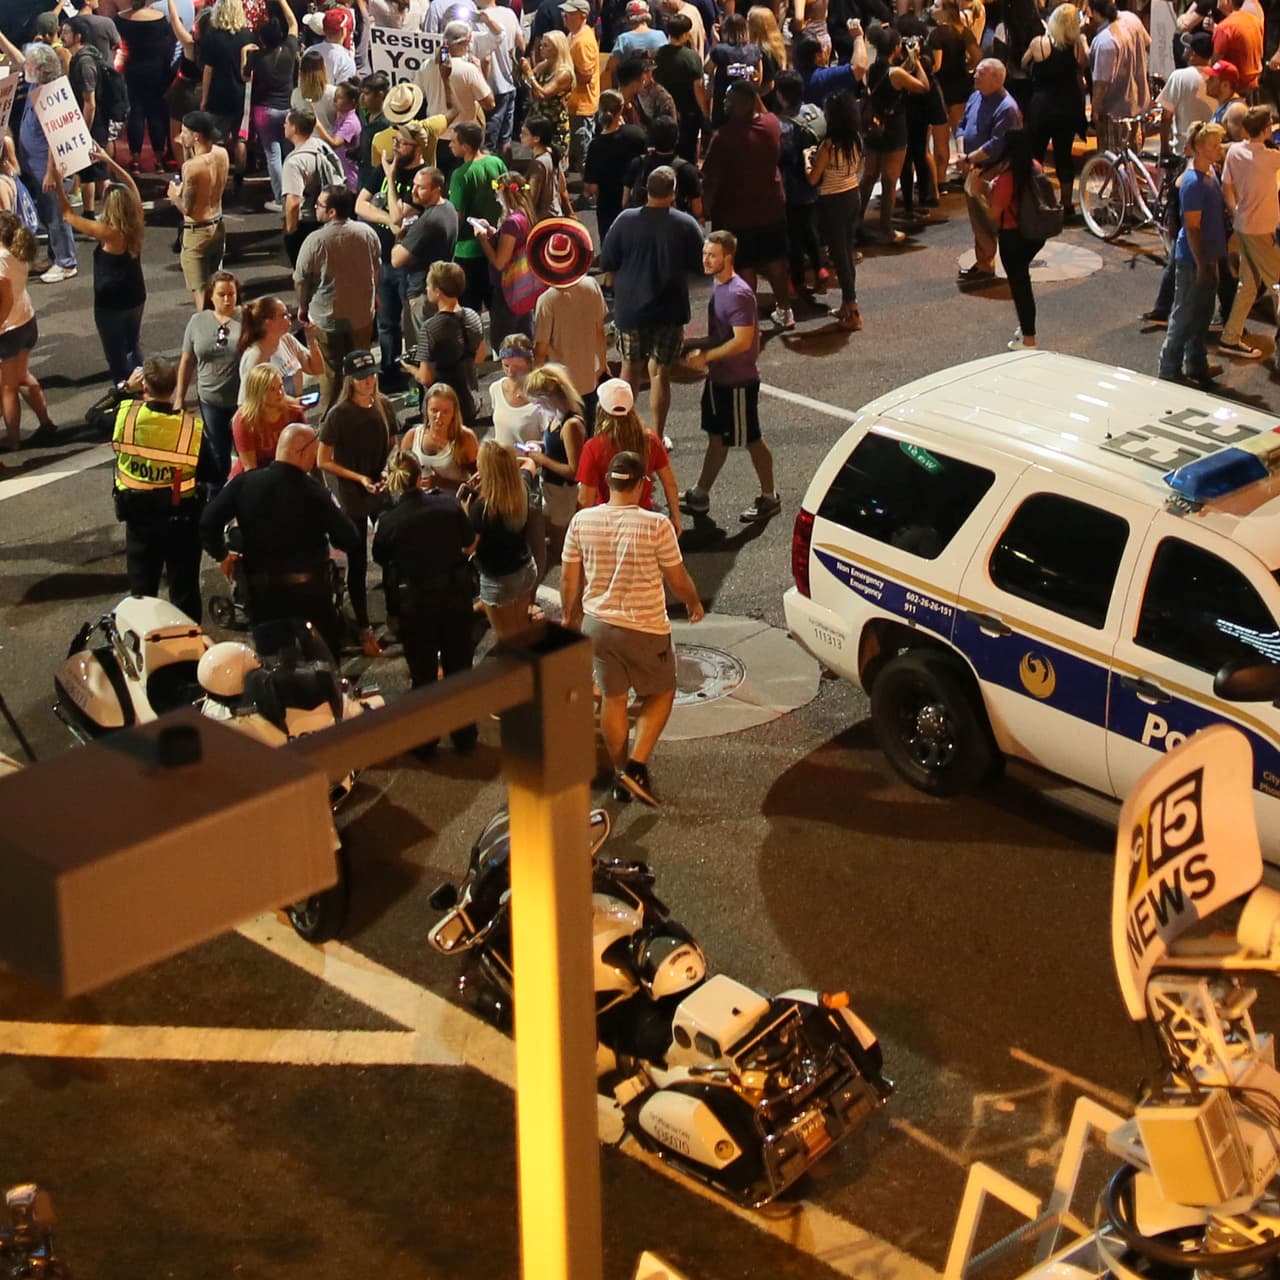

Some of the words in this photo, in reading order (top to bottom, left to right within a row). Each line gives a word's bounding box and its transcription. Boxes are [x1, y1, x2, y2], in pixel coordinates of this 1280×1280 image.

[39, 87, 69, 111] LOVE
[44, 108, 81, 134] TRUMPS
[55, 132, 87, 157] HATE
[836, 561, 850, 574] Non
[850, 567, 885, 590] Emergency
[849, 578, 883, 601] Emergency
[903, 602, 917, 614] 911
[1262, 771, 1280, 788] City
[1150, 778, 1198, 864] 15
[1126, 853, 1216, 970] NEWS
